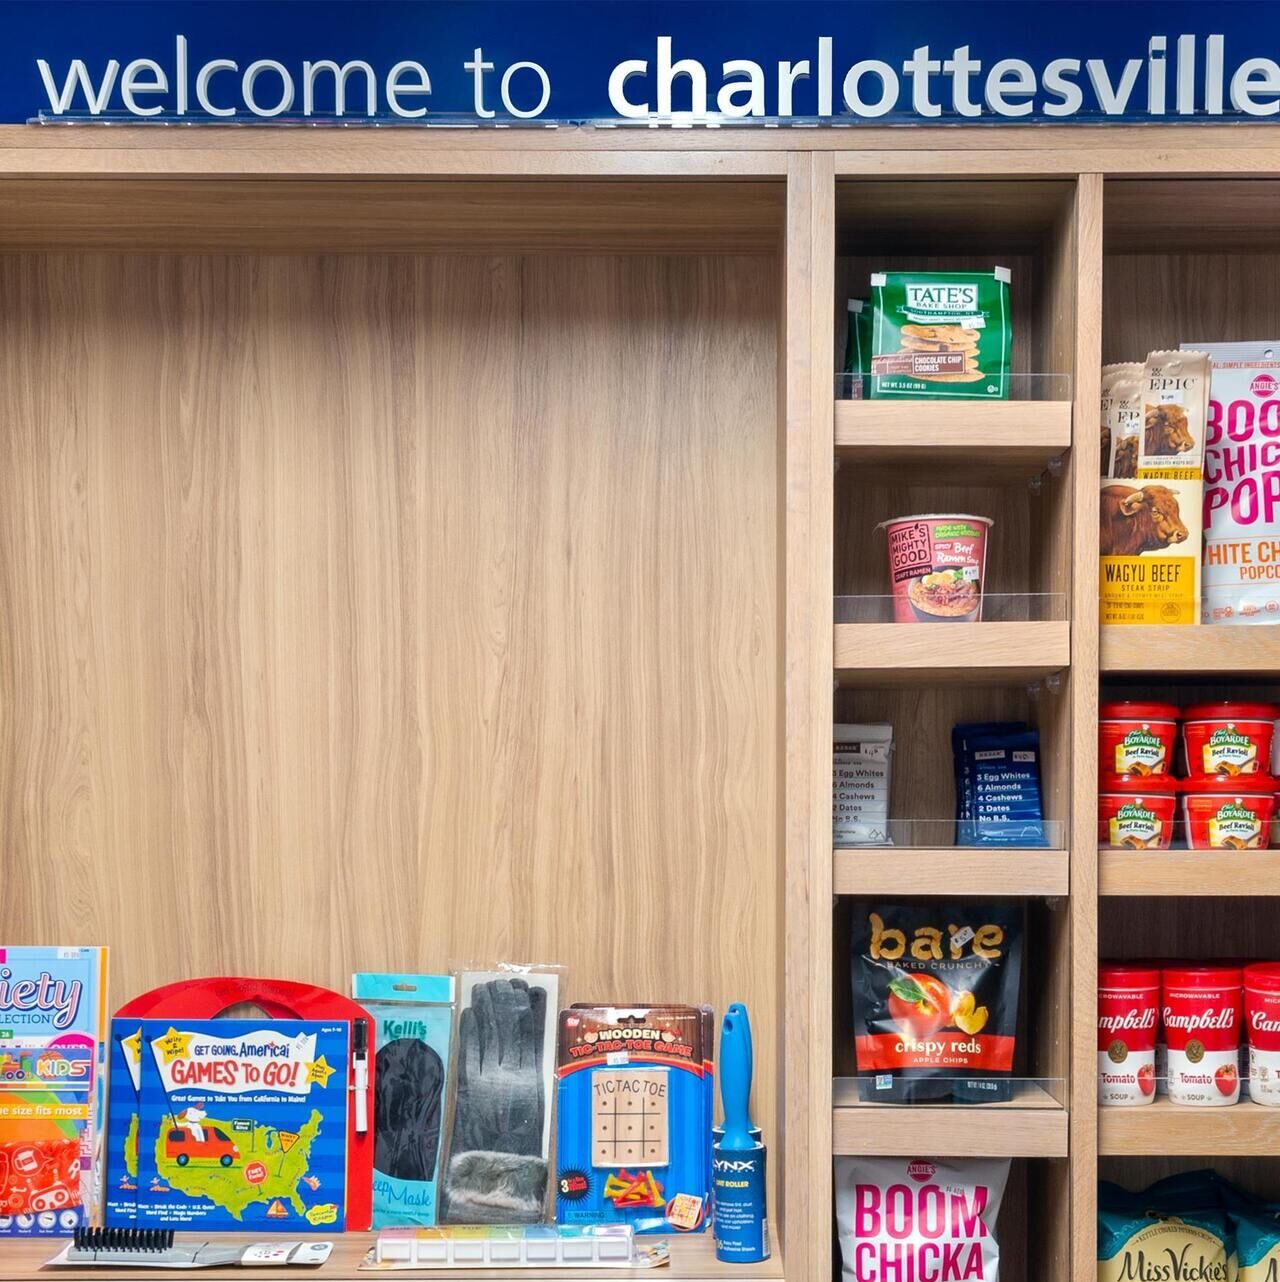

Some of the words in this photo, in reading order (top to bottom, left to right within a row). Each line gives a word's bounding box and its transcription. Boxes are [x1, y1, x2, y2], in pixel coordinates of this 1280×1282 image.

[36, 36, 433, 117] welcome
[465, 46, 550, 118] to
[909, 287, 974, 304] TATE'S
[1149, 378, 1195, 391] EPIC
[891, 528, 926, 544] MIKE'S
[892, 539, 927, 554] MIGHTY
[894, 549, 928, 567] GOOD
[1105, 565, 1145, 583] WAGYU
[1151, 564, 1181, 582] BEEF
[983, 773, 999, 781] Egg
[1001, 771, 1030, 779] Whites
[839, 781, 875, 789] Almonds
[985, 783, 1021, 791] Almonds
[985, 793, 1023, 802] Cashews
[868, 912, 1004, 961] bare
[887, 961, 926, 970] BAKED
[930, 961, 990, 970] CRUNCHY
[383, 1020, 427, 1036] Kelli's
[1163, 1007, 1234, 1033] Campbell's
[599, 1029, 660, 1040] WOODEN
[194, 1045, 210, 1056] GET
[570, 1040, 654, 1058] TIC-TAC-TOE
[655, 1041, 693, 1057] GAME
[895, 1039, 945, 1057] crispy
[951, 1038, 981, 1053] reds
[37, 1059, 88, 1077] KIDS
[171, 1059, 238, 1085] GAMES
[263, 1061, 300, 1088] GO!
[1101, 1073, 1136, 1083] Tomato
[1180, 1073, 1213, 1084] Tomato
[594, 1080, 615, 1097] TIC
[616, 1079, 640, 1092] TAC
[643, 1080, 666, 1098] TOE
[12, 1106, 33, 1115] size
[35, 1105, 53, 1115] fits
[55, 1106, 82, 1115] most
[855, 1183, 988, 1239] BOOM
[1117, 1250, 1170, 1282] Miss
